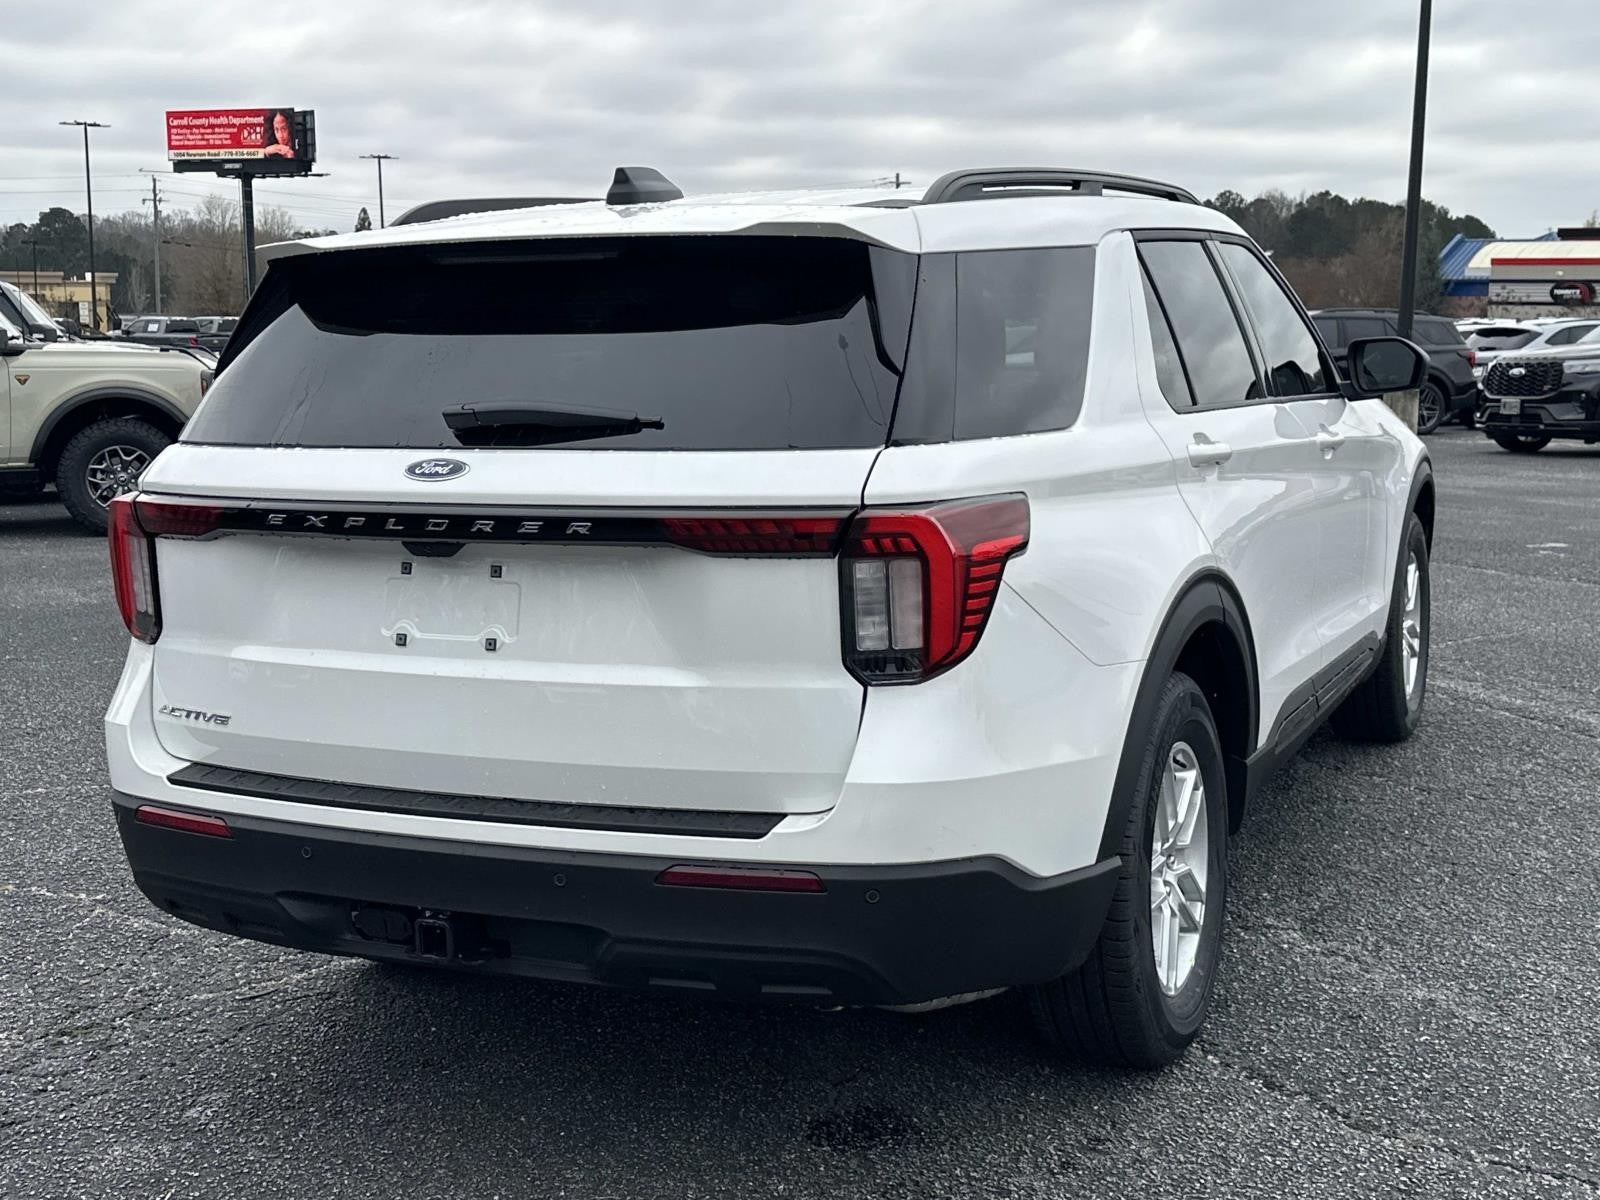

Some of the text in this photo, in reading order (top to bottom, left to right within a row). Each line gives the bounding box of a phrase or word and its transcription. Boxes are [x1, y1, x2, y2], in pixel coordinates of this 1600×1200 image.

[169, 115, 265, 127] Carroll County Health Department
[414, 460, 454, 475] Ford
[267, 513, 593, 535] EXPLORER
[158, 704, 232, 726] ACTIVE
